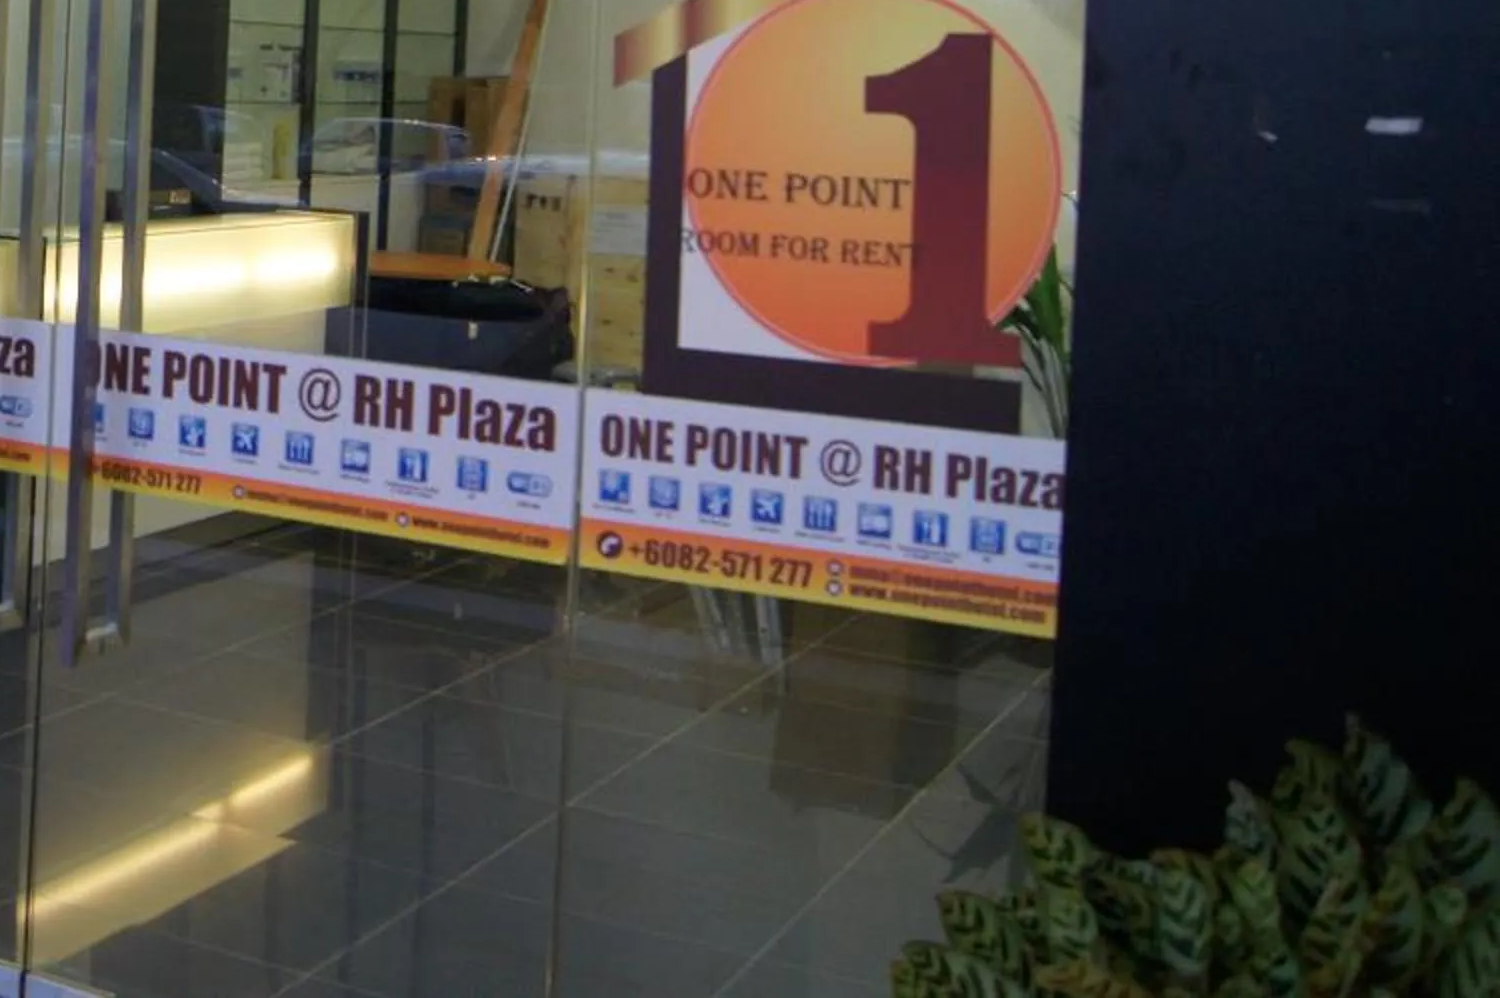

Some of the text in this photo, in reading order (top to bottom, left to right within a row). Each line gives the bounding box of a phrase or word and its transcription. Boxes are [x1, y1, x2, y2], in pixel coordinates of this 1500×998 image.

[688, 168, 912, 210] ONE POINT
[770, 234, 829, 263] FOR
[162, 349, 287, 414] POINT
[298, 367, 342, 422] @
[353, 373, 414, 432] RH
[427, 382, 557, 453] Plaza
[600, 414, 1066, 511] ONE POINT @ RH Plaza
[627, 536, 764, 582] +6082-571
[769, 557, 813, 589] 277
